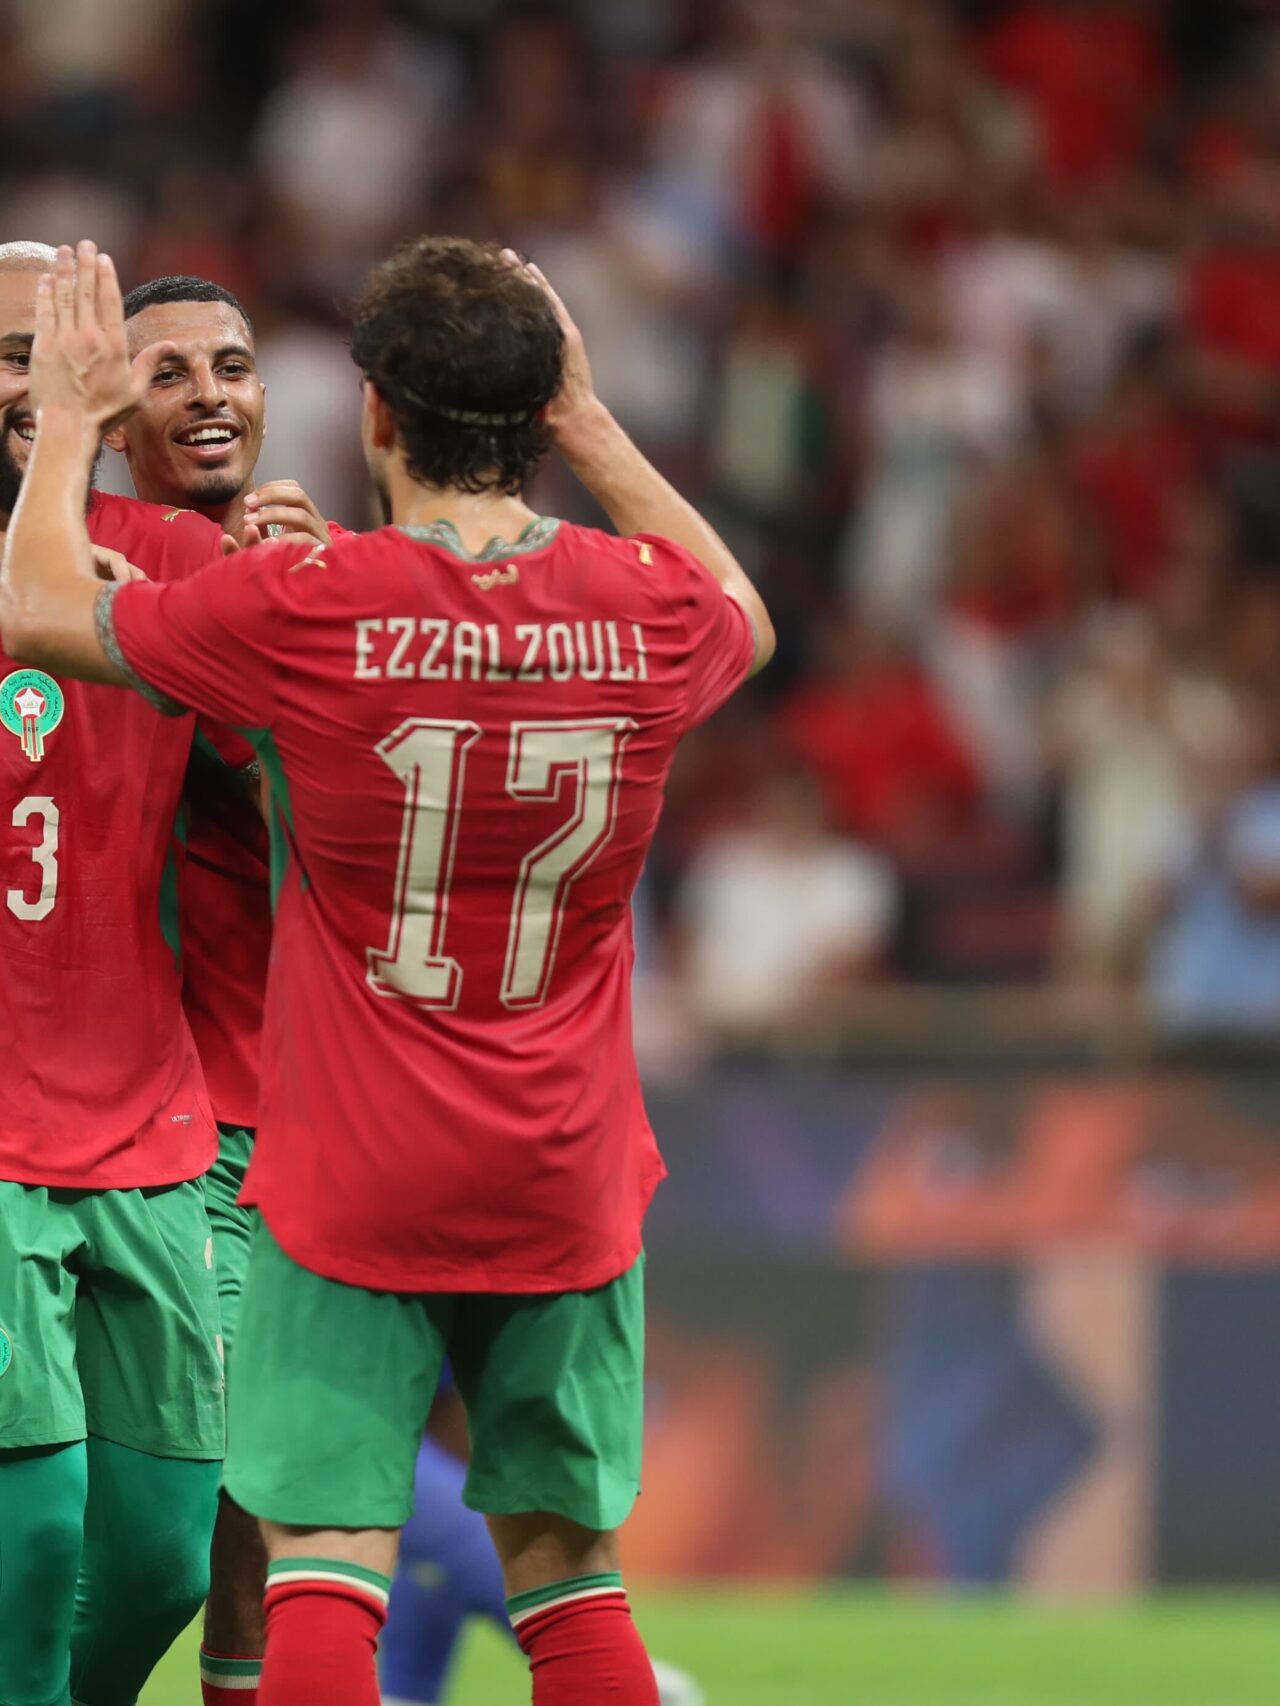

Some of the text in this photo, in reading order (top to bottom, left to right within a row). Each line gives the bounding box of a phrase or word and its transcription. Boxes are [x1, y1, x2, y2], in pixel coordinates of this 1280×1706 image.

[354, 616, 648, 681] EZZALZOULI
[7, 796, 60, 921] 3
[366, 717, 640, 1012] 17
